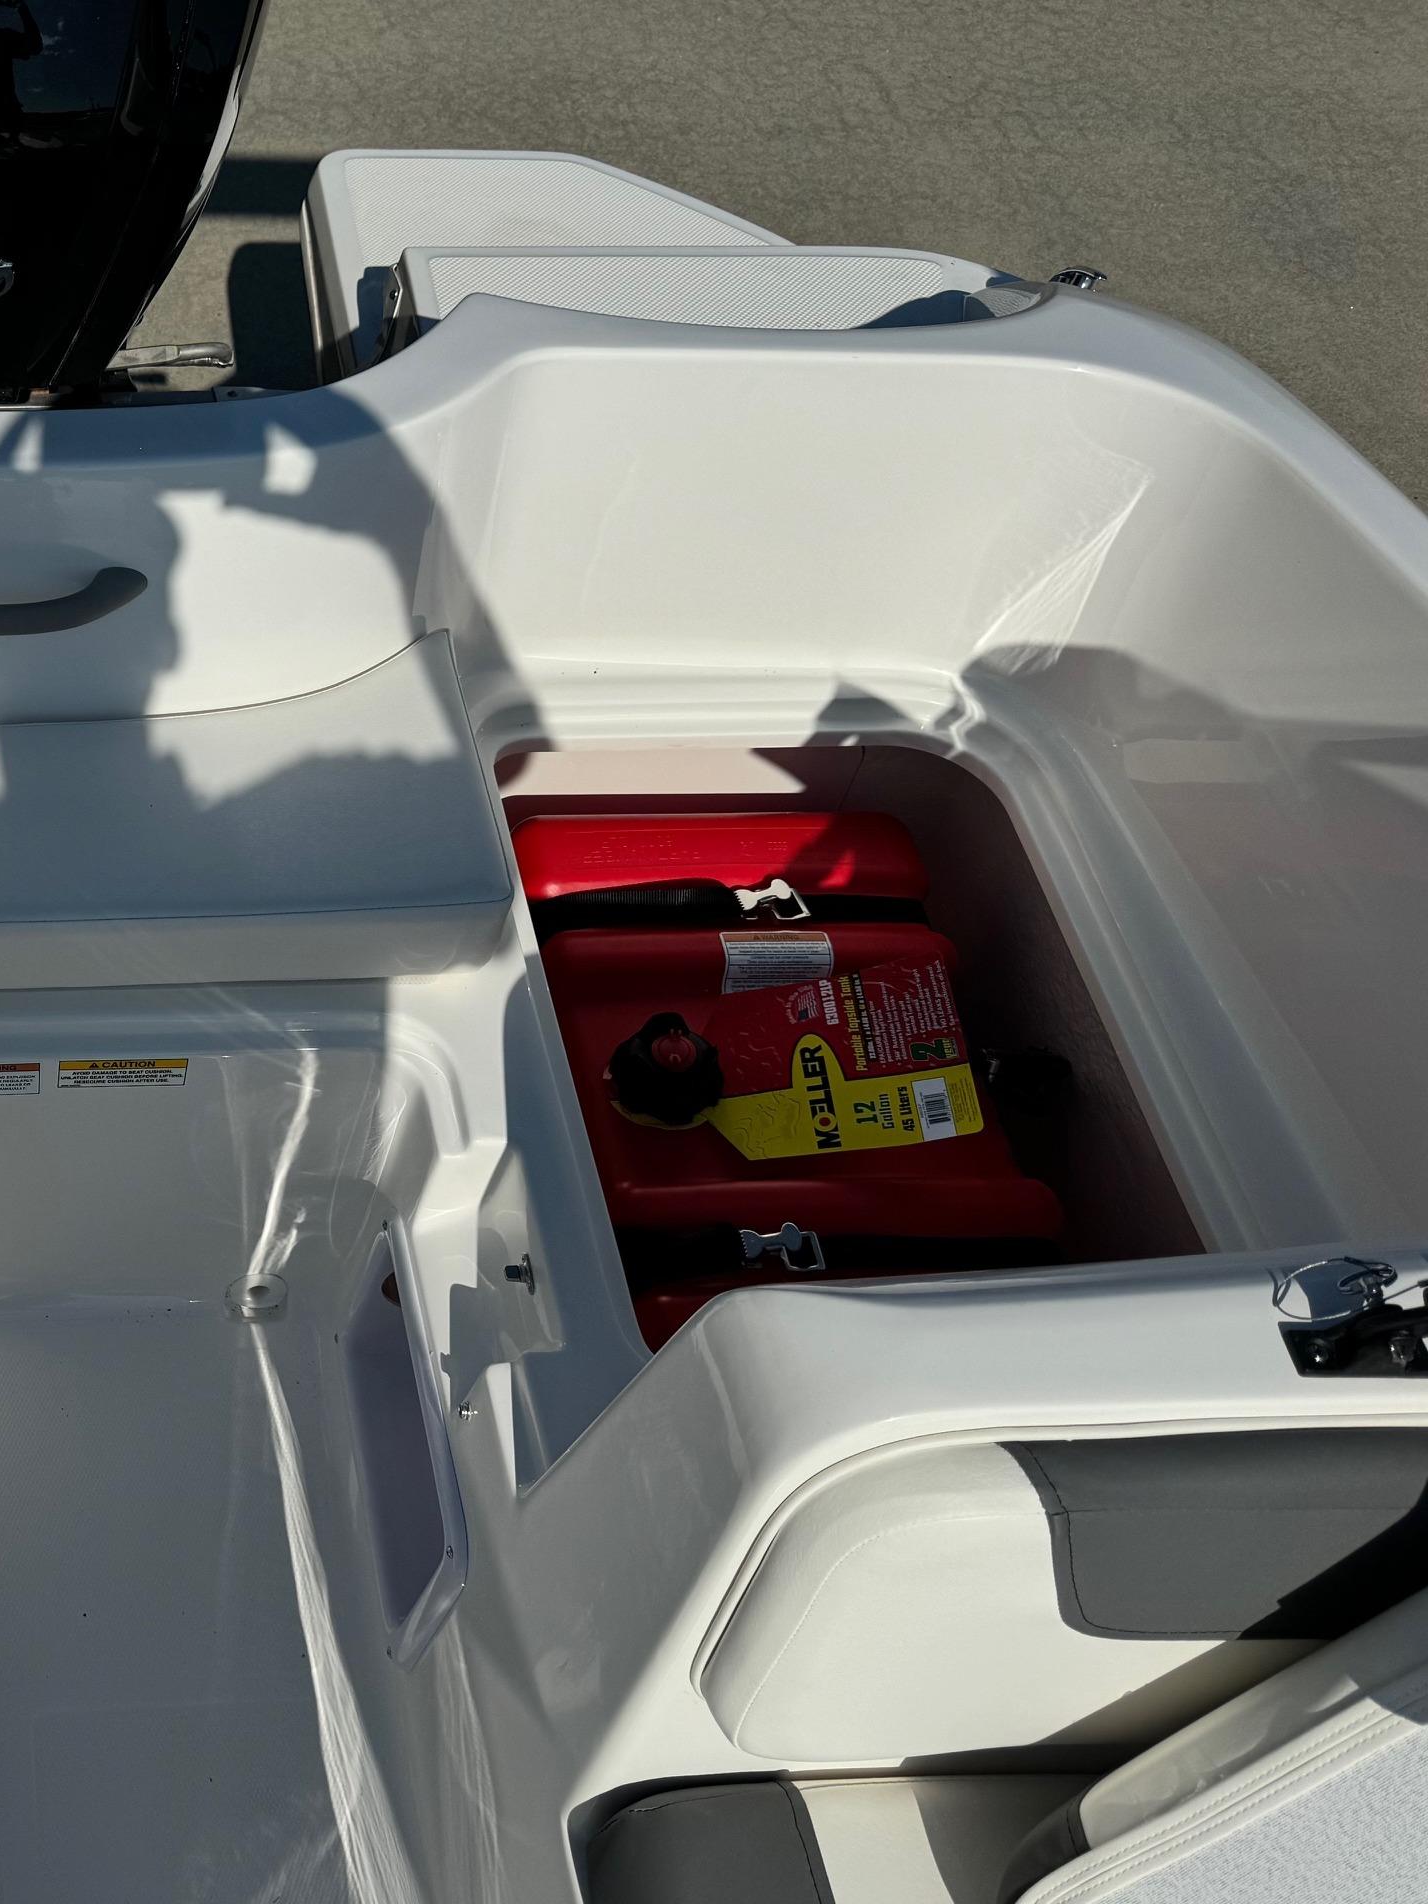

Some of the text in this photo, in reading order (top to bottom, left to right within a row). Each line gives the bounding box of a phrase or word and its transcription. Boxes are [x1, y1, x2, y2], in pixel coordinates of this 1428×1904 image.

[819, 979, 839, 1025] 630012LP
[838, 975, 852, 997] Tank
[843, 999, 860, 1032] Topside
[850, 1034, 868, 1071] Portable
[909, 1037, 944, 1061] 2
[799, 1044, 842, 1149] MOELLER
[854, 1101, 878, 1124] 12
[879, 1093, 895, 1129] Gallon
[897, 1086, 915, 1132] 45 Liters
